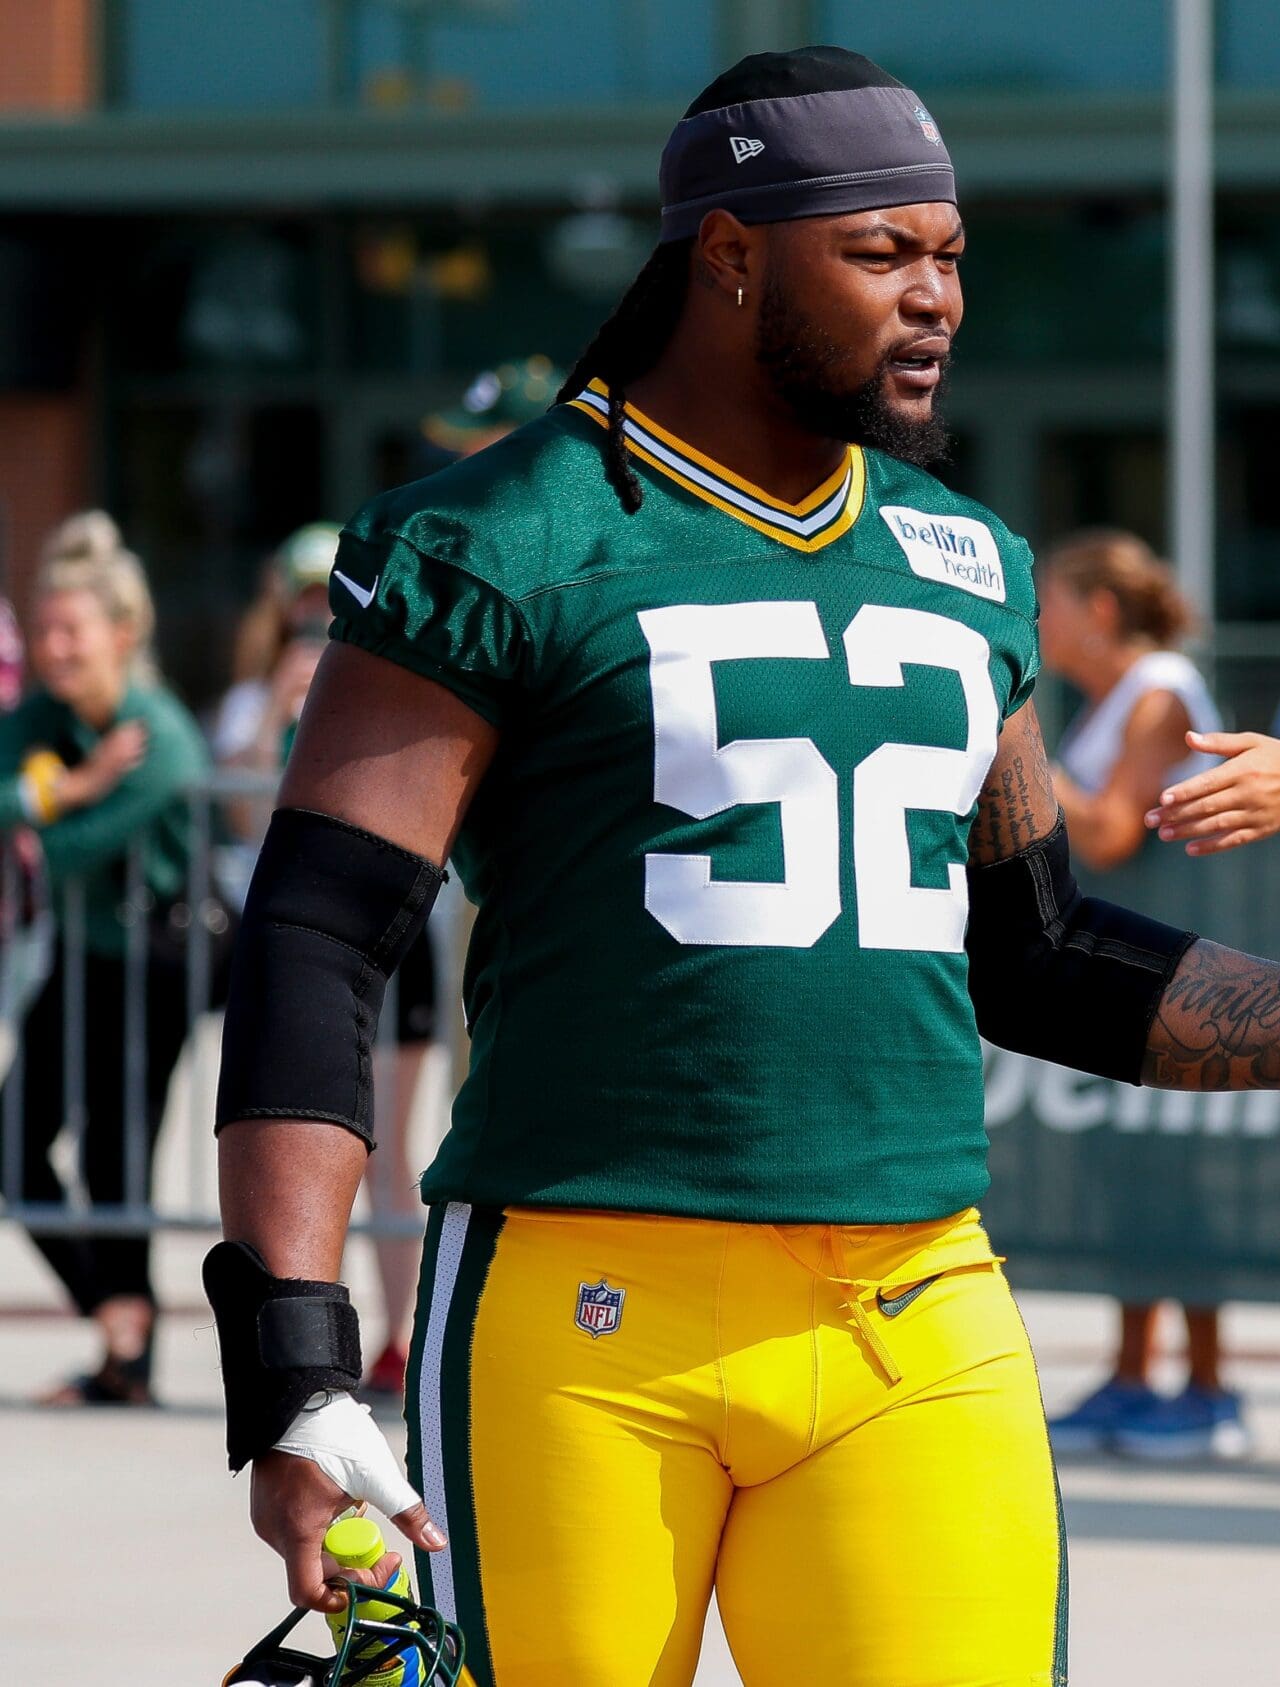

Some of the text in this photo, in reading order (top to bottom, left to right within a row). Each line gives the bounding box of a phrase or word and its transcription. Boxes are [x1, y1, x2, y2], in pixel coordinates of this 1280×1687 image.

[893, 514, 977, 558] bellin
[941, 552, 1001, 591] health
[637, 600, 999, 954] 52
[582, 1304, 614, 1328] NFL
